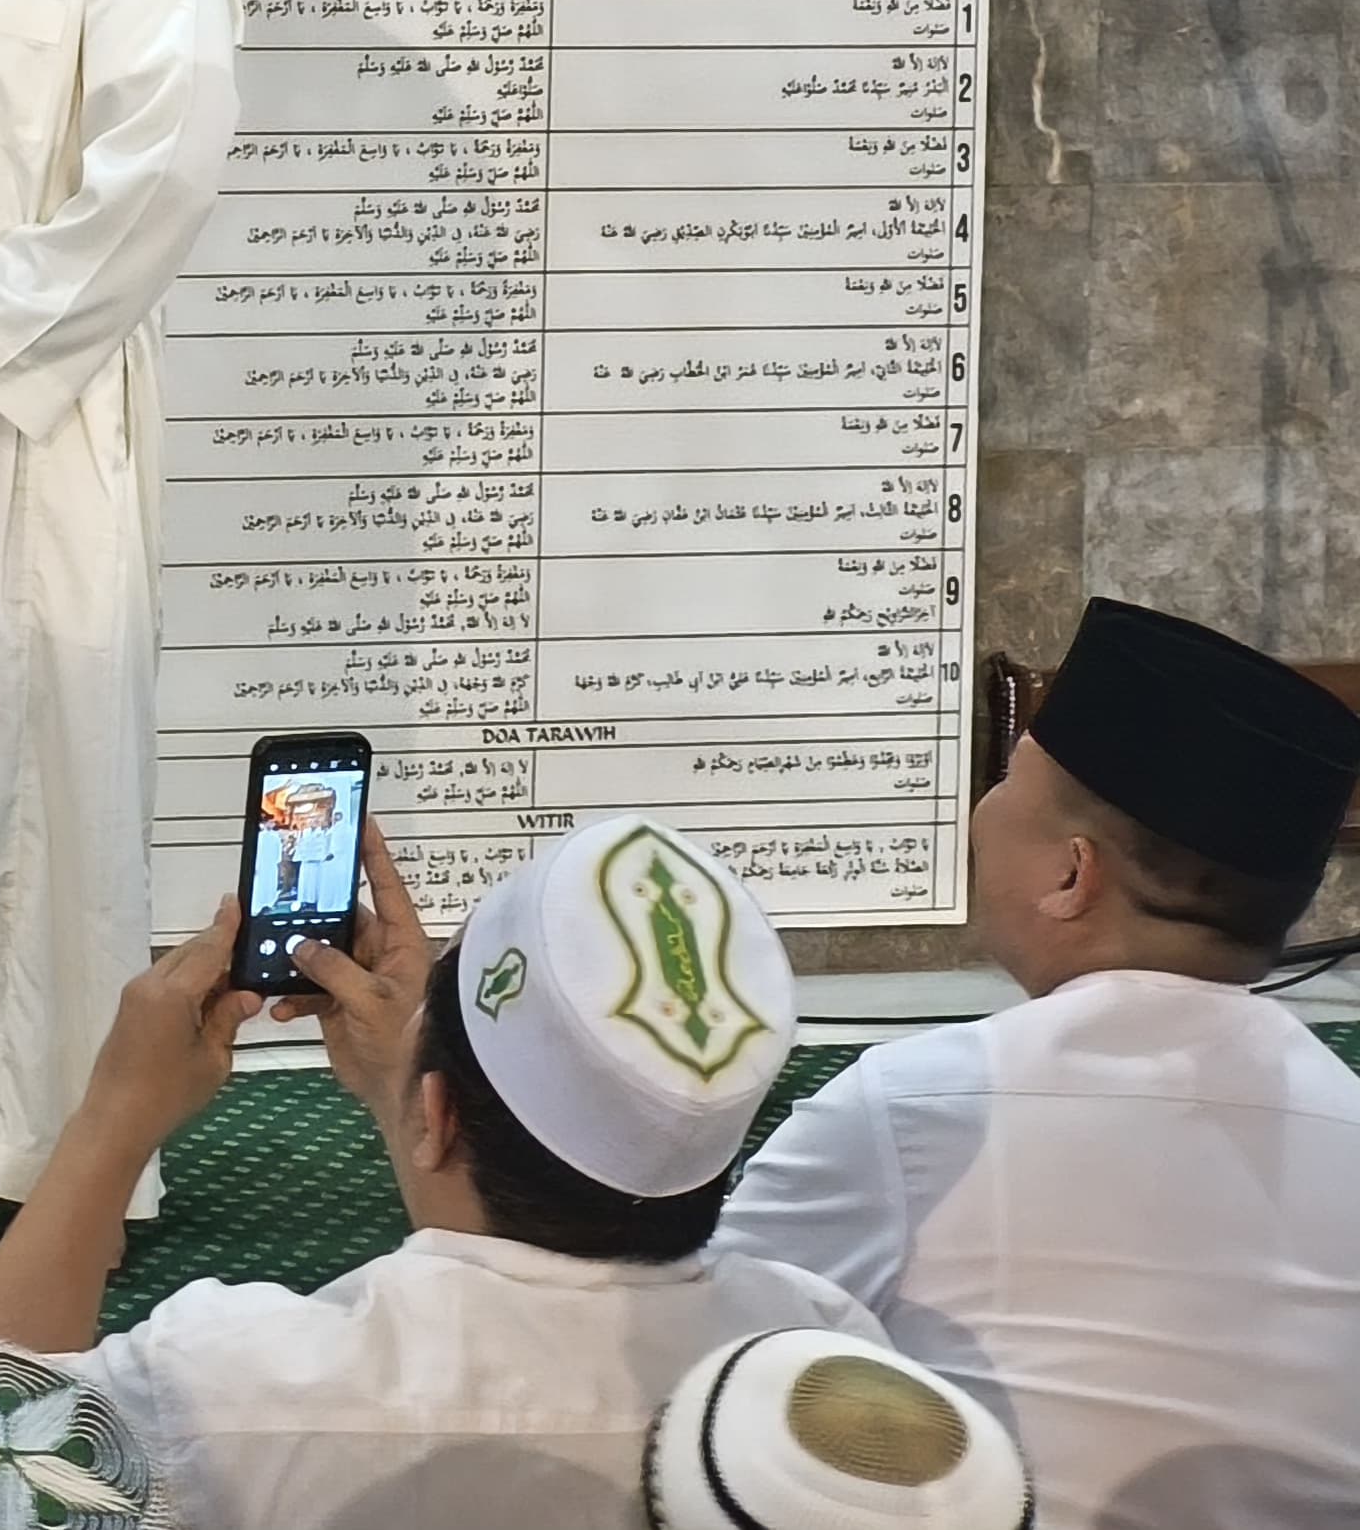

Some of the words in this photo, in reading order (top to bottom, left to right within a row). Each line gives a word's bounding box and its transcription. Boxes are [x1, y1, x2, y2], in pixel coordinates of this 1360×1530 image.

[961, 2, 973, 34] 1
[958, 73, 972, 102] 2
[957, 143, 970, 172] 3
[955, 214, 969, 242] 4
[954, 284, 967, 312] 5
[952, 353, 965, 381] 6
[951, 424, 963, 452] 7
[949, 494, 962, 522] 8
[946, 577, 960, 605] 9
[941, 662, 960, 682] 10
[481, 728, 521, 747] DOA
[526, 724, 617, 745] TARAWIH
[516, 812, 574, 831] WITIR
